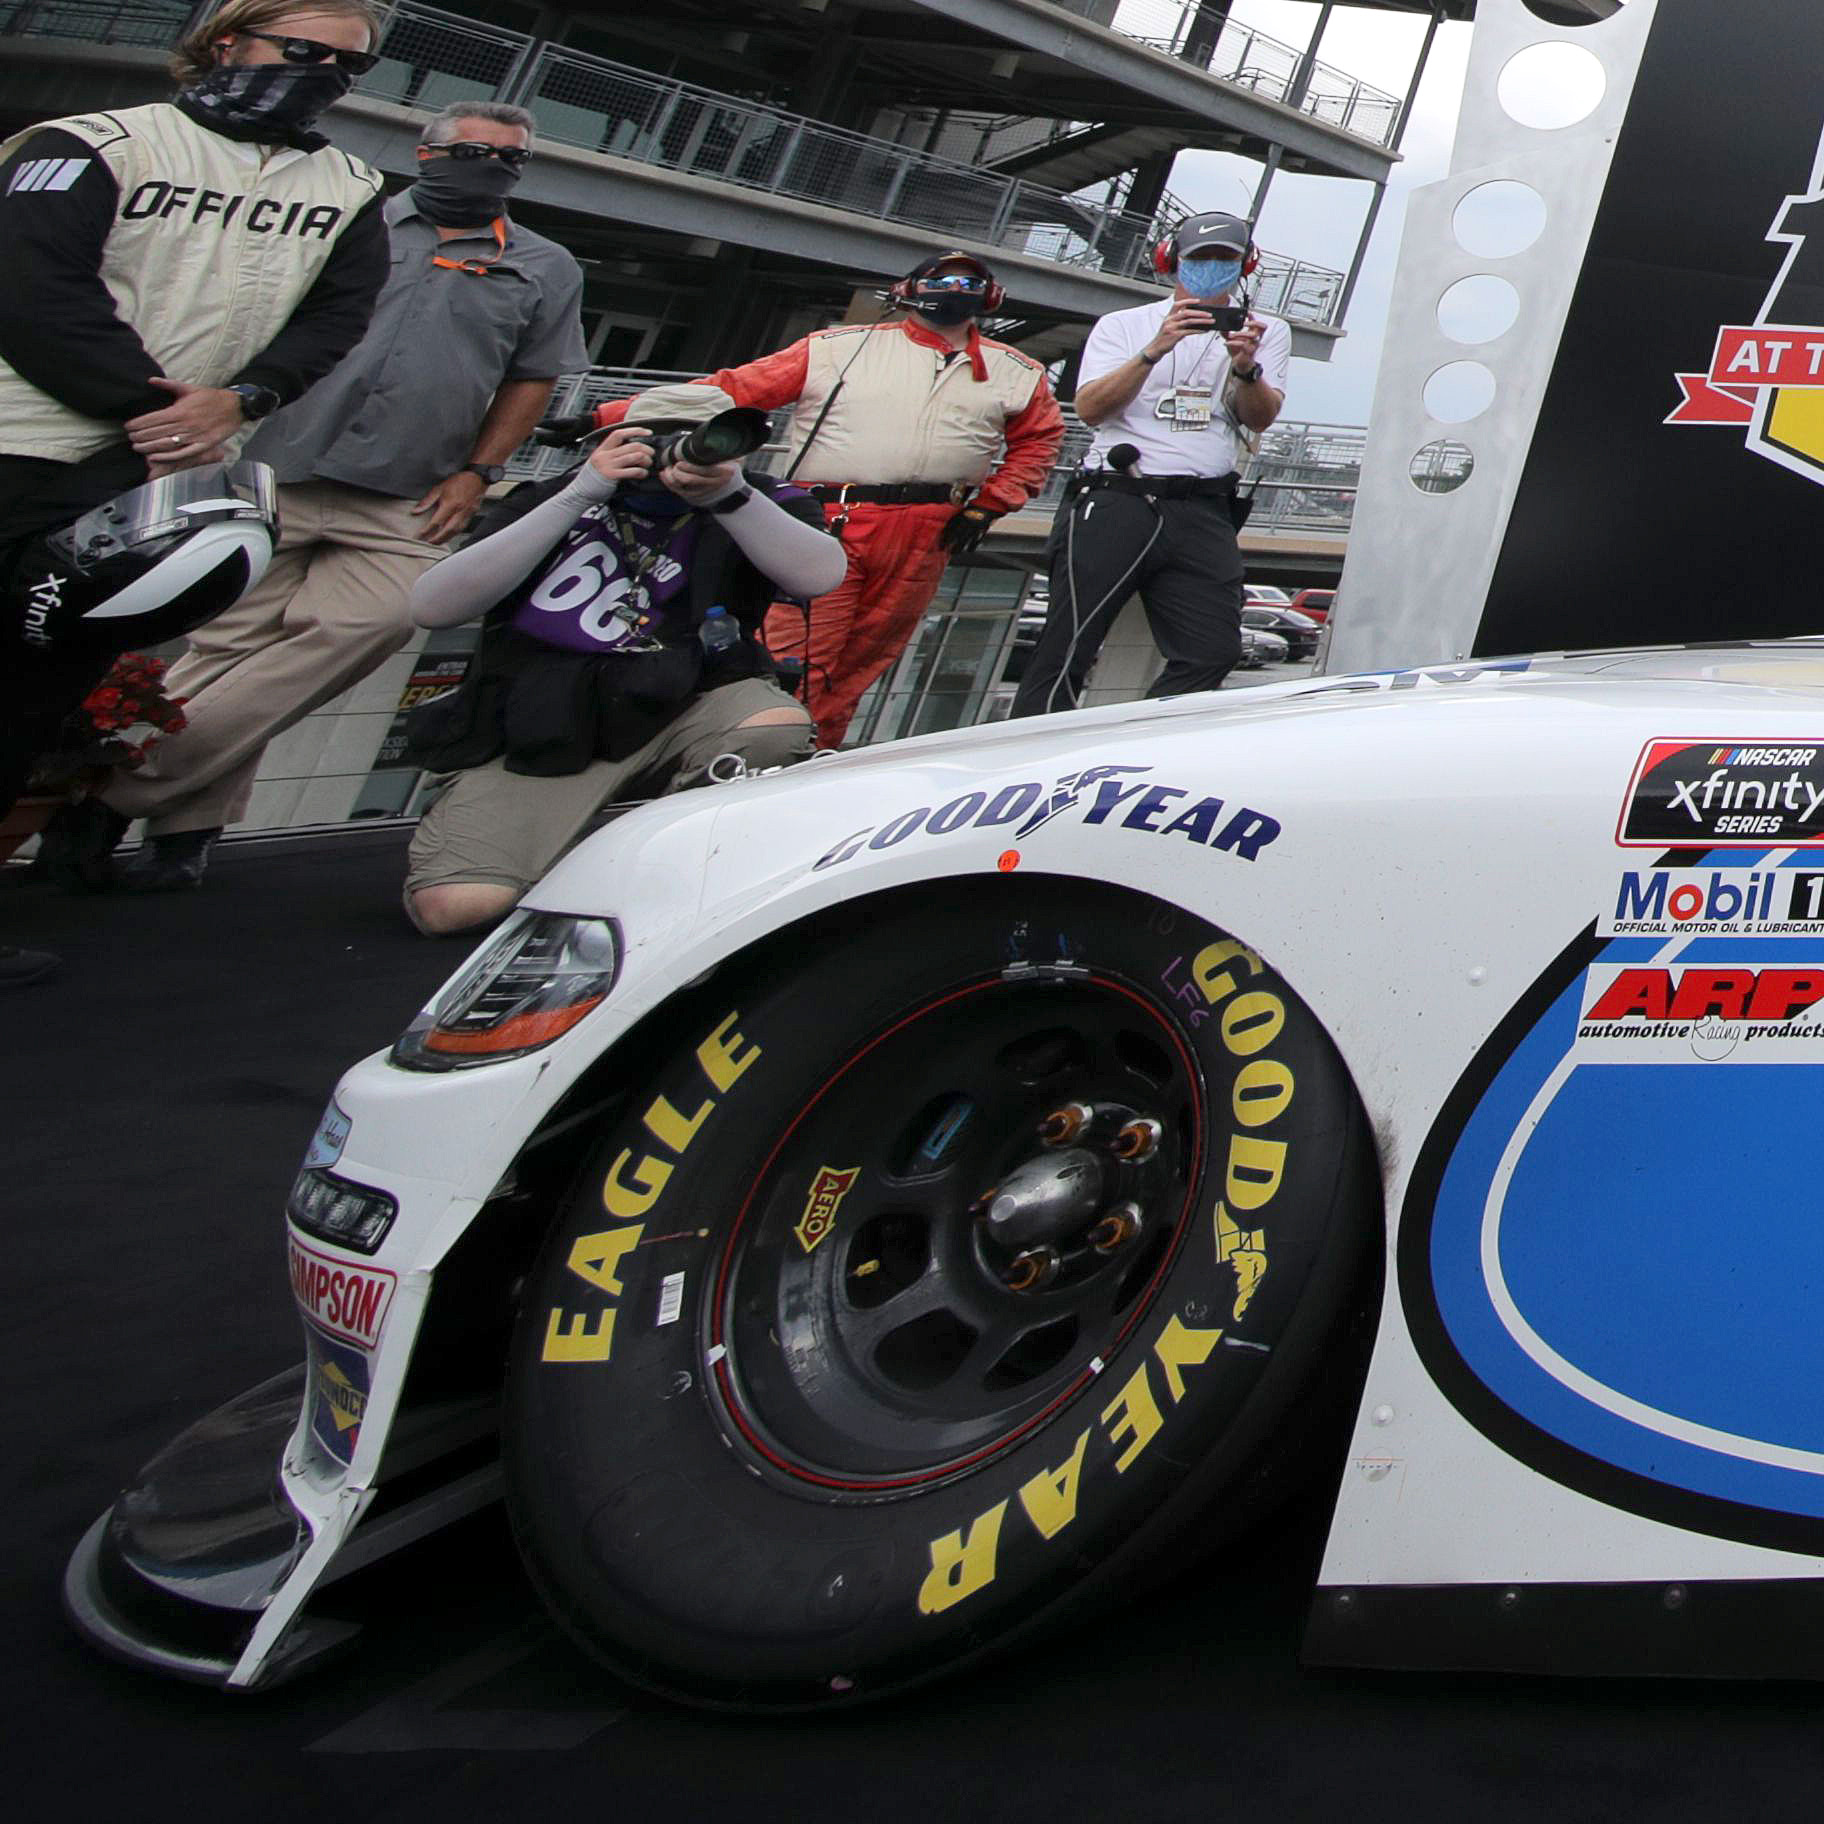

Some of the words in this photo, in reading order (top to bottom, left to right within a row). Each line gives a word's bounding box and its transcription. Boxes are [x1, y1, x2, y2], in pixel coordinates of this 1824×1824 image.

[1726, 340, 1794, 376] AT
[1734, 748, 1816, 766] NASCAR
[814, 766, 1282, 873] GOODYEAR
[1713, 815, 1783, 833] SERIES
[1615, 872, 1776, 921] Mobil
[1613, 923, 1667, 933] OFFICIAL
[1671, 923, 1717, 933] MOTOR
[1720, 923, 1740, 933] OIL
[1743, 923, 1752, 933] &
[1578, 1022, 1690, 1039] automotive
[543, 1010, 762, 1363] EAGLE
